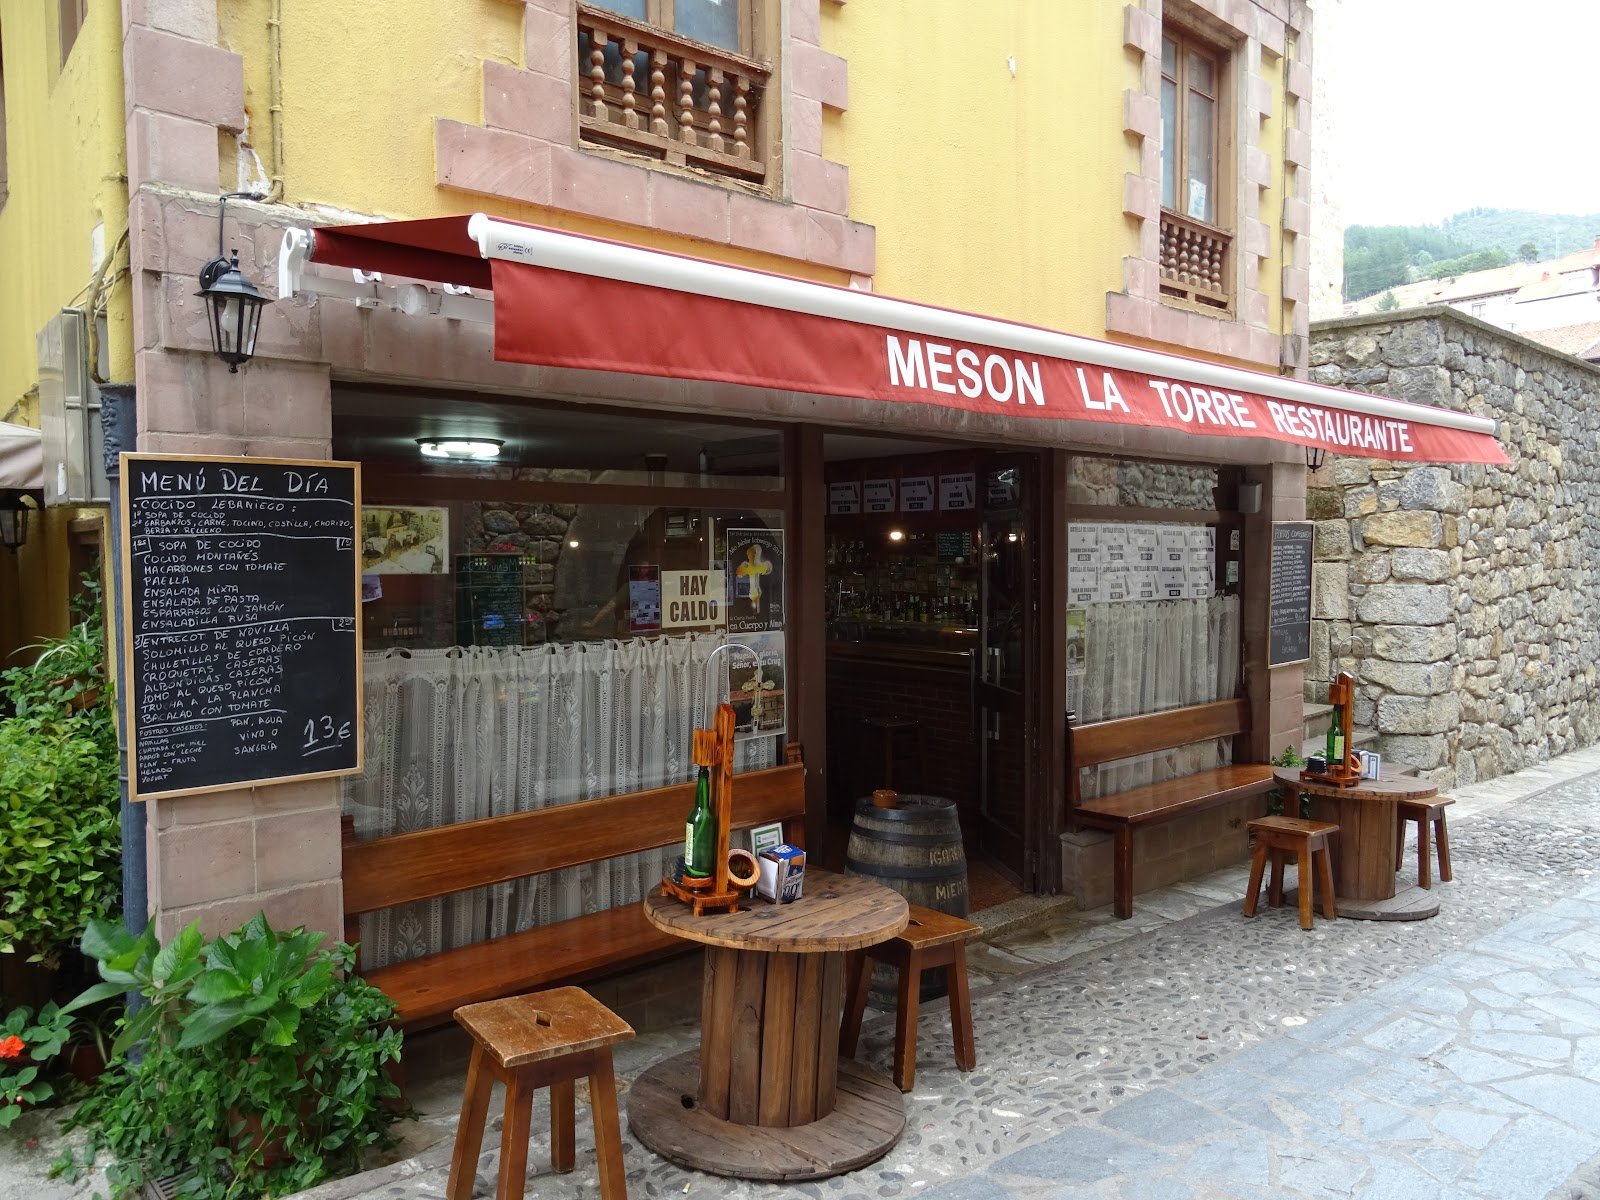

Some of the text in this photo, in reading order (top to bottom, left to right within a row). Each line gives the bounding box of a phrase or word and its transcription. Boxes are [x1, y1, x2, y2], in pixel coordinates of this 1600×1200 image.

[886, 334, 1414, 453] MESON LA TORRE RESTAURANTE
[141, 467, 328, 494] MENÚ DEL DÍA
[158, 541, 187, 550] SOPA
[196, 540, 212, 550] DE
[144, 564, 213, 575] MACARRONES
[245, 563, 287, 571] TOMATE
[143, 576, 190, 586] PAELLA
[680, 575, 708, 596] HAY
[144, 587, 200, 597] ENSALADA
[142, 595, 260, 608] ENSALADA DE PASTA
[218, 605, 238, 613] CON
[670, 600, 718, 622] CALDO
[228, 613, 258, 622] RUSA
[142, 633, 206, 648] ENTRECOT
[214, 630, 230, 640] DE
[215, 642, 228, 650] AL
[236, 637, 272, 648] QUESO
[227, 651, 241, 660] DE
[248, 643, 302, 656] CORDERO
[142, 655, 280, 682] CROQUETAS CASERAS
[229, 665, 283, 678] CASERAS
[177, 689, 192, 697] AL
[199, 683, 232, 694] QUESO
[208, 695, 221, 703] LA
[229, 684, 280, 700] PLANCHA
[200, 706, 222, 715] CON
[228, 699, 271, 711] TOMATE
[259, 716, 283, 725] AGUA
[302, 715, 351, 748] 13€
[140, 768, 173, 776] HELADO
